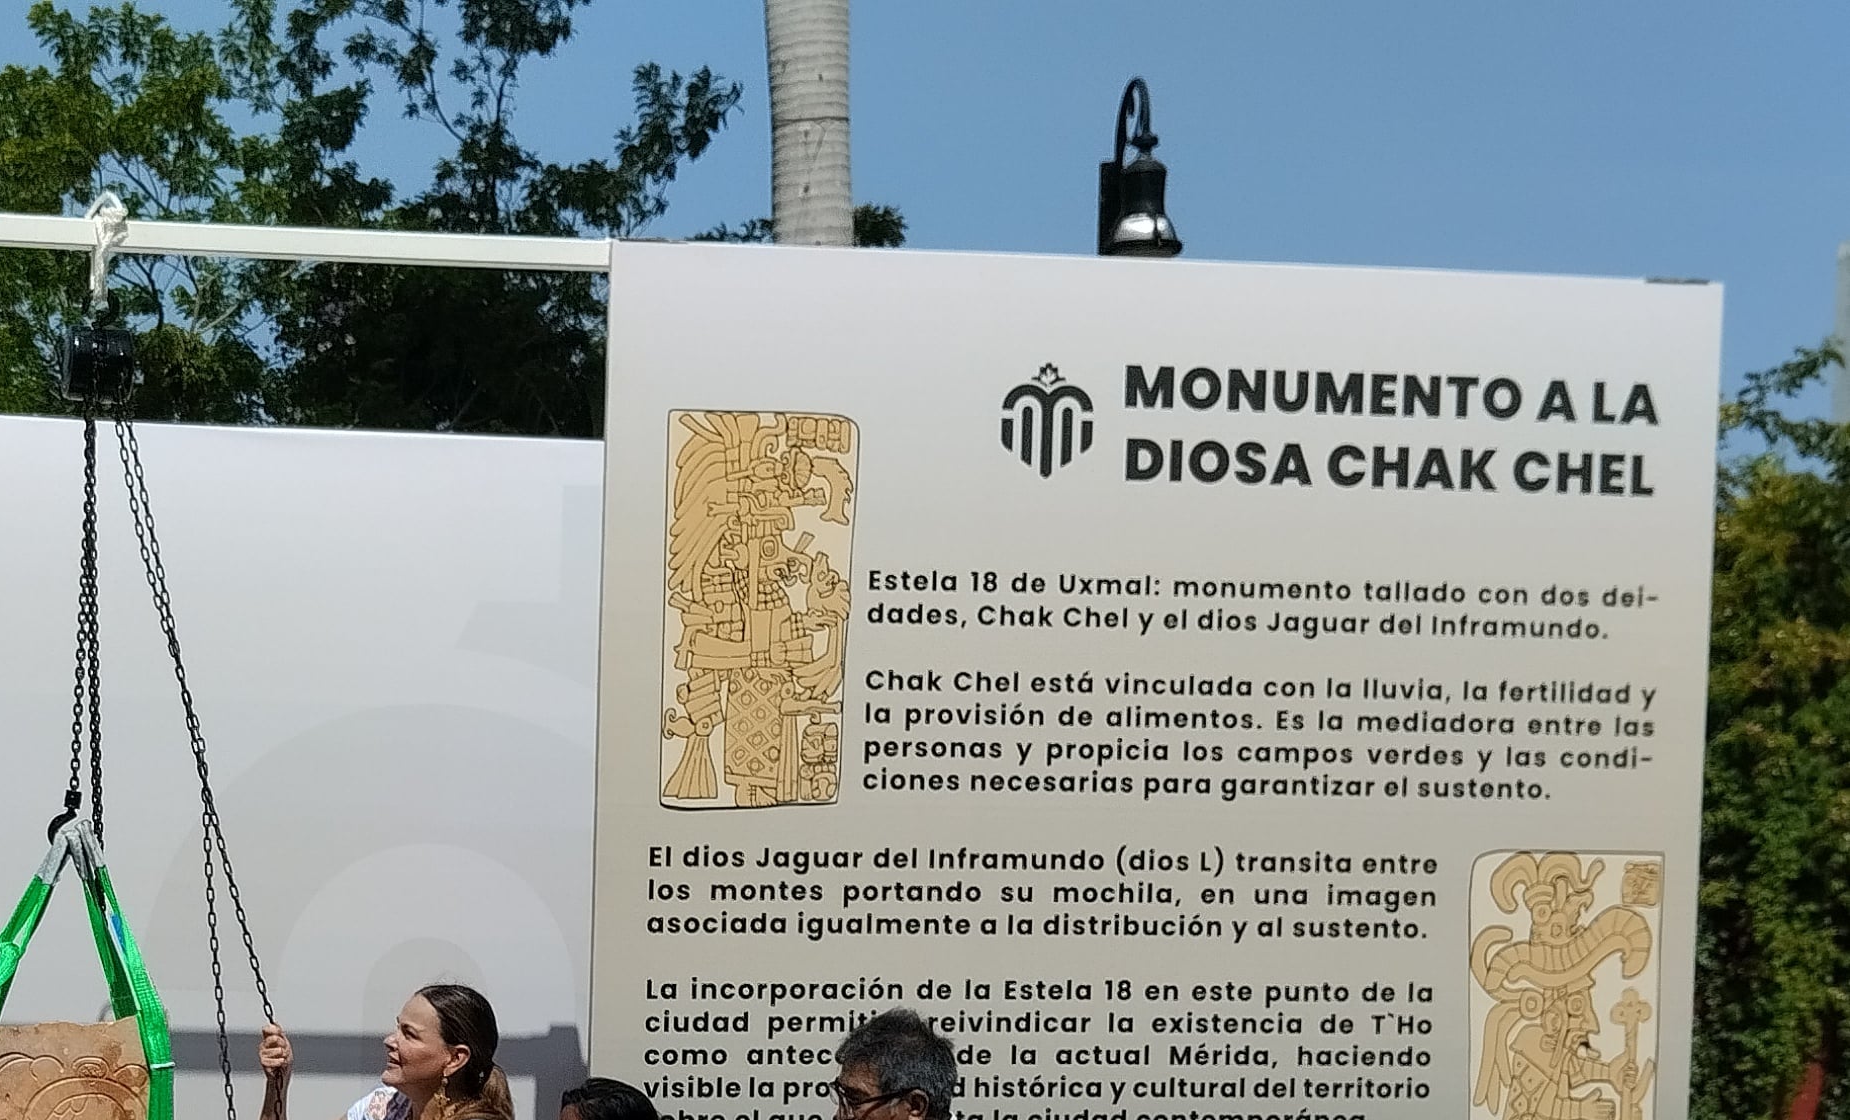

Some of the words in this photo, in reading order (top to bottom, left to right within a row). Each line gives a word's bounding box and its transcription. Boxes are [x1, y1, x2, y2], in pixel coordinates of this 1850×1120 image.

[1124, 364, 1523, 422] MONUMENTO
[1535, 379, 1578, 424] A
[1591, 381, 1660, 427] LA
[1124, 437, 1313, 487] DIOSA
[1327, 444, 1498, 493] CHAK
[1512, 450, 1655, 497] CHEL
[868, 569, 958, 592] Estela
[970, 571, 998, 594] 18
[1010, 571, 1047, 594] de
[1058, 573, 1161, 596] Uxmal:
[1173, 580, 1352, 602] monumento
[1363, 579, 1466, 604] tallado
[1478, 587, 1528, 606] con
[1540, 583, 1590, 608] dos
[1601, 585, 1658, 608] dei-
[867, 602, 967, 629] dades,
[977, 604, 1054, 628] Chak
[1063, 605, 1128, 629] Chel
[1137, 612, 1155, 637] y
[1163, 608, 1188, 631] el
[1197, 607, 1257, 632] dios
[1266, 611, 1371, 640] Jaguar
[1379, 612, 1422, 636] del
[1431, 613, 1608, 640] Inframundo.
[865, 669, 943, 692] Chak
[953, 670, 1020, 693] Chel
[1030, 670, 1094, 694] está
[1104, 671, 1253, 697] vinculada
[1263, 680, 1315, 699] con
[1326, 677, 1352, 699] la
[1363, 677, 1451, 705] lluvia,
[1463, 680, 1488, 702] la
[1498, 680, 1631, 705] fertilidad
[1641, 689, 1657, 713] y
[865, 701, 891, 724] la
[904, 701, 1045, 732] provisión
[1057, 705, 1093, 727] de
[1105, 705, 1263, 731] alimentos.
[1276, 709, 1305, 731] Es
[1317, 709, 1344, 732] la
[1356, 710, 1515, 735] mediadora
[1527, 715, 1602, 737] entre
[1614, 715, 1655, 737] las
[863, 740, 1002, 765] personas
[1015, 742, 1033, 767] y
[1046, 737, 1169, 768] propicia
[1183, 740, 1224, 762] los
[1237, 745, 1353, 771] campos
[1367, 744, 1464, 767] verdes
[1476, 749, 1493, 774] y
[1506, 745, 1547, 768] las
[1559, 746, 1653, 769] condi-
[862, 766, 960, 791] ciones
[970, 769, 1134, 794] necesarias
[1143, 776, 1211, 801] para
[1220, 773, 1376, 802] garantizar
[1383, 775, 1408, 798] el
[1417, 778, 1551, 801] sustento.
[649, 845, 672, 868] El
[682, 844, 745, 868] dios
[755, 847, 864, 876] Jaguar
[873, 847, 918, 869] del
[928, 846, 1105, 871] Inframundo
[1116, 844, 1189, 877] (dios
[1200, 845, 1224, 878] L)
[1235, 850, 1352, 874] transita
[1362, 854, 1438, 875] entre
[648, 878, 691, 901] los
[710, 880, 823, 902] montes
[843, 880, 982, 910] portando
[1000, 885, 1033, 903] su
[1053, 880, 1182, 908] mochila,
[1200, 887, 1235, 906] en
[1254, 888, 1308, 906] una
[1327, 883, 1436, 914] imagen
[646, 910, 787, 934] asociada
[797, 910, 971, 942] igualmente
[980, 918, 997, 936] a
[1007, 913, 1033, 936] la
[1043, 912, 1222, 938] distribución
[1231, 920, 1248, 944] y
[1256, 916, 1283, 938] al
[1292, 918, 1427, 939] sustento.
[646, 978, 678, 1000] La
[691, 976, 903, 1008] incorporación
[916, 978, 952, 1000] de
[964, 978, 991, 1000] la
[1004, 979, 1092, 1001] Estela
[1104, 979, 1132, 1001] 18
[1144, 984, 1179, 1002] en
[1191, 981, 1253, 1002] este
[1264, 982, 1350, 1009] punto
[1361, 981, 1396, 1003] de
[1407, 981, 1433, 1003] la
[645, 1009, 749, 1033] ciudad
[928, 1009, 1092, 1034] reivindicar
[1108, 1011, 1134, 1033] la
[1151, 1011, 1303, 1035] existencia
[1319, 1013, 1354, 1035] de
[644, 1048, 728, 1066] como
[957, 1044, 992, 1065] de
[1011, 1043, 1037, 1066] la
[1055, 1044, 1150, 1066] actual
[1169, 1042, 1278, 1070] Mérida,
[1297, 1044, 1431, 1067] haciendo
[643, 1074, 742, 1099] visible
[749, 1076, 775, 1098] la
[974, 1074, 1102, 1098] histórica
[1109, 1081, 1127, 1106] y
[1132, 1076, 1246, 1099] cultural
[1253, 1077, 1296, 1099] del
[1303, 1076, 1430, 1099] territorio
